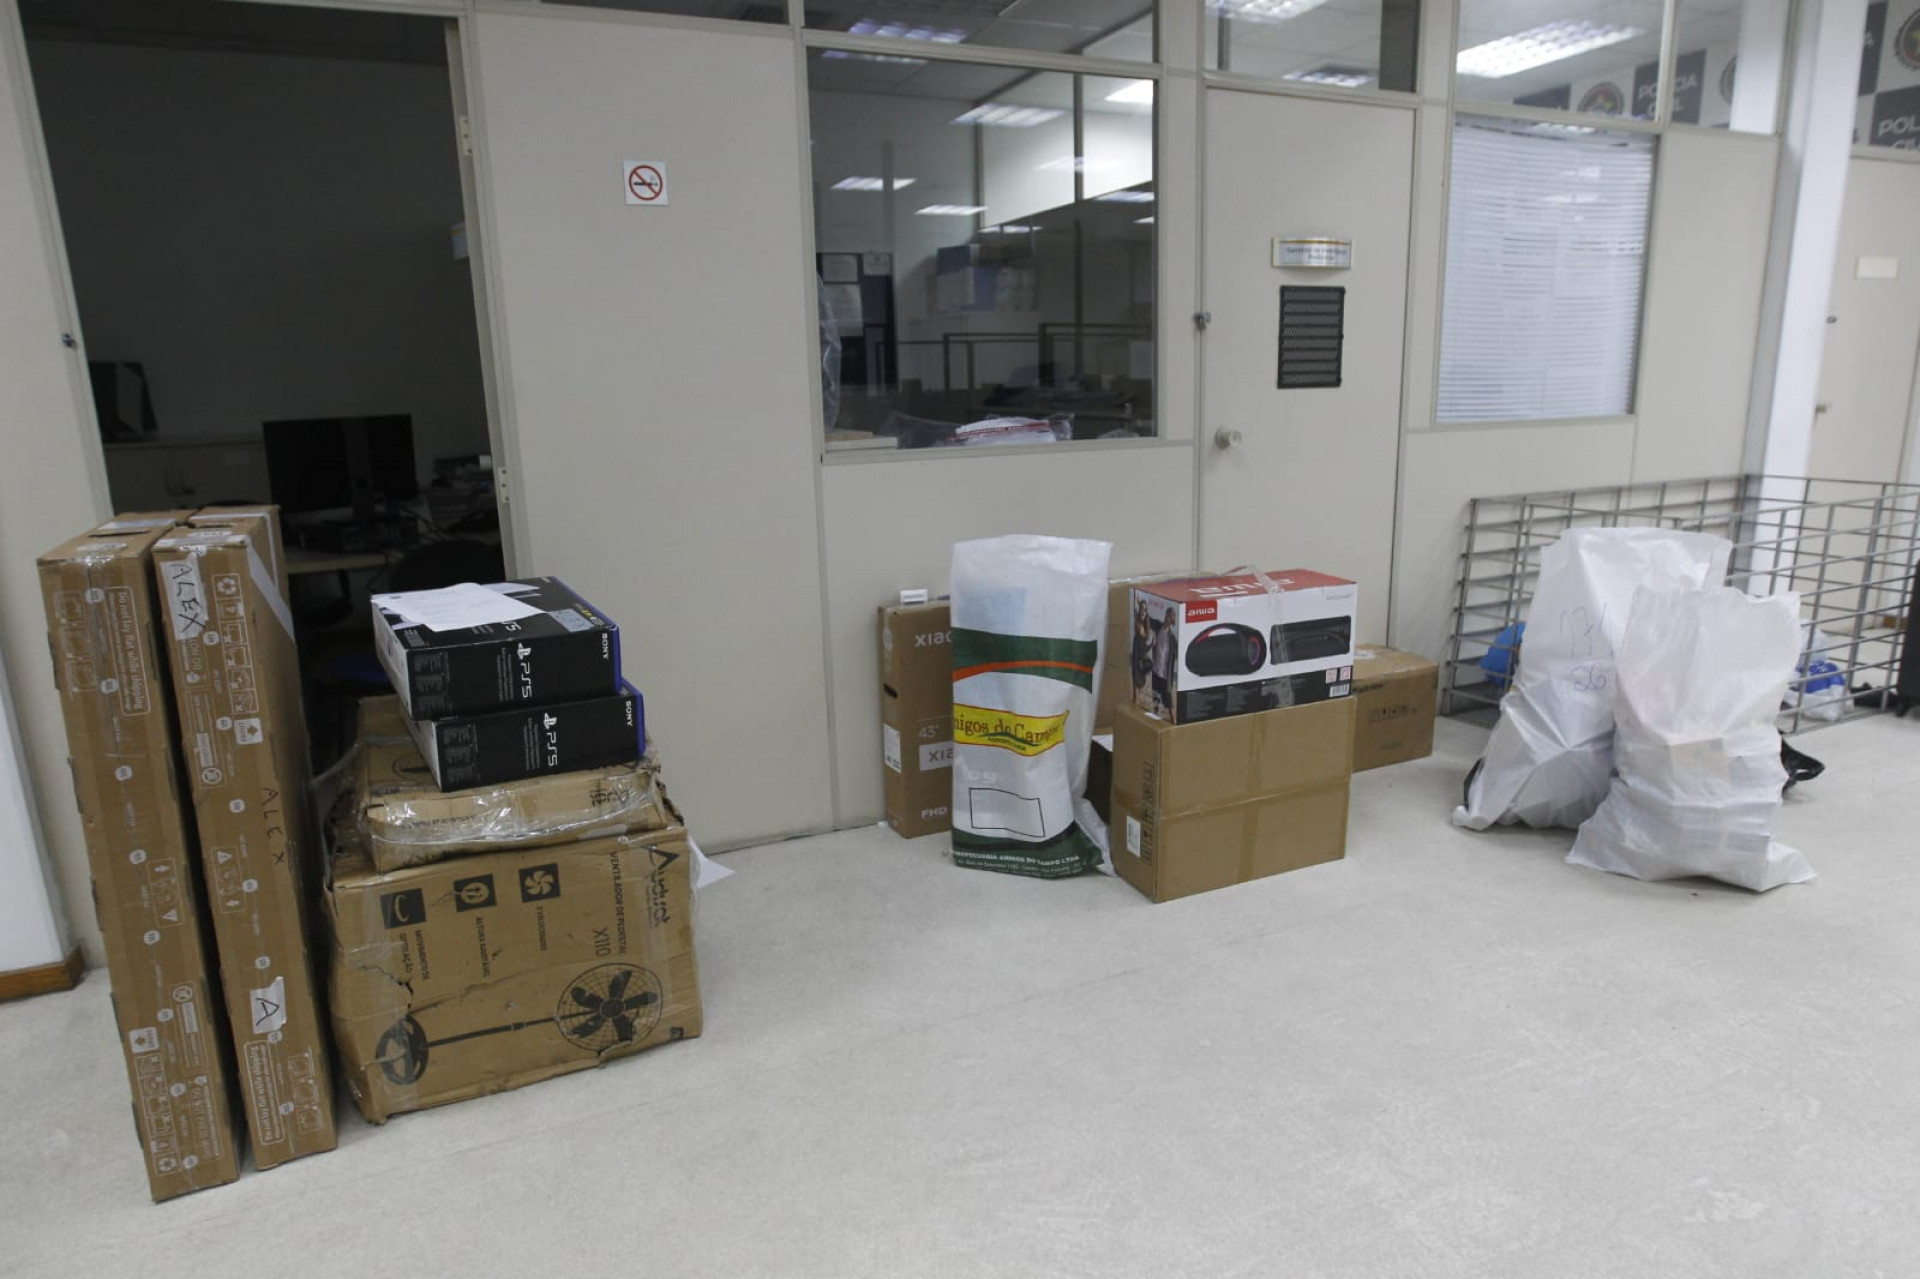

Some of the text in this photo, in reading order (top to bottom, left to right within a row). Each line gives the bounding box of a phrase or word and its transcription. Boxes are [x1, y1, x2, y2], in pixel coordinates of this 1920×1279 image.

[1638, 73, 1698, 101] POCIA
[171, 563, 205, 633] ALEX
[1187, 607, 1215, 618] aiwa
[601, 633, 609, 660] SONY
[914, 631, 953, 648] xiao
[520, 662, 532, 698] PS5
[625, 700, 633, 727] SONY
[546, 731, 558, 767] PS5
[921, 806, 948, 819] FHD
[609, 852, 623, 904] VENTILADOR
[593, 928, 612, 957] X110
[615, 918, 628, 954] PEDESTAL
[256, 996, 280, 1027] A
